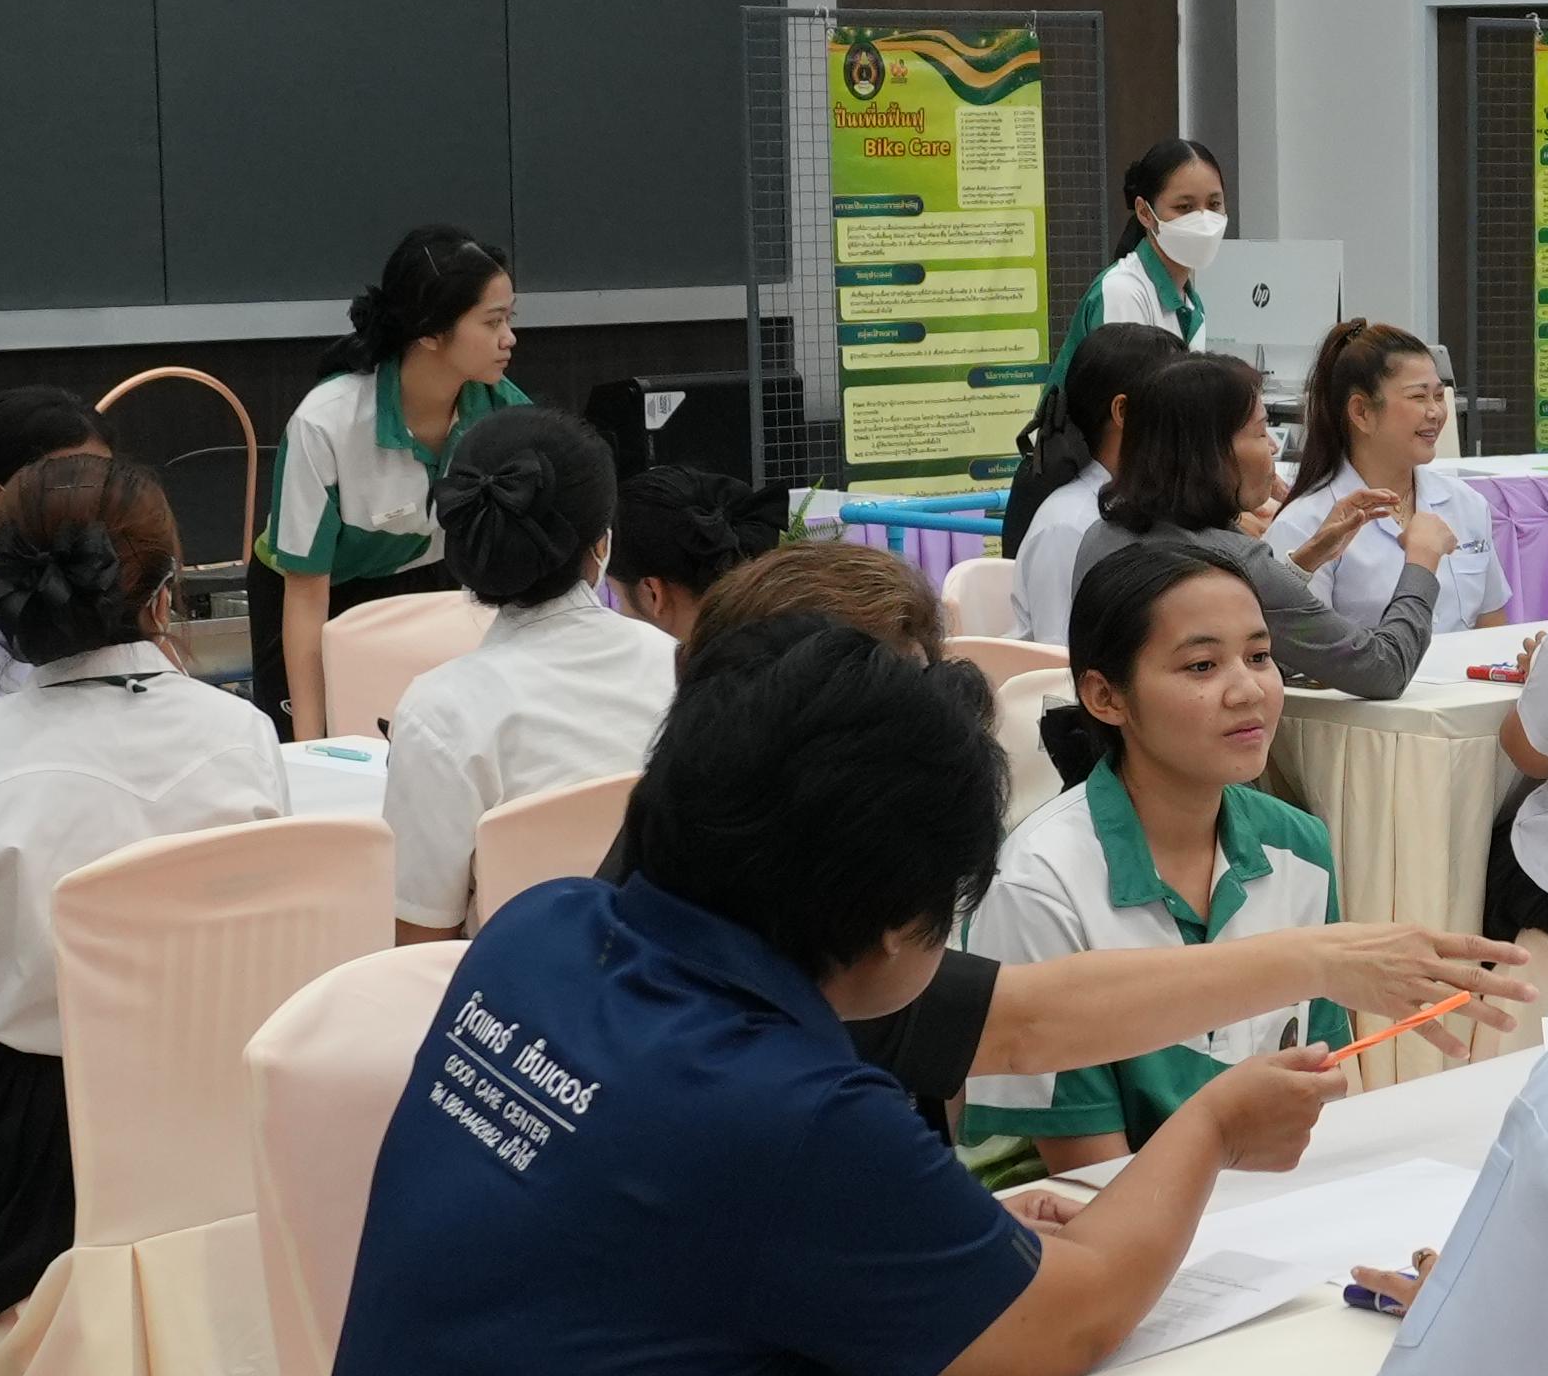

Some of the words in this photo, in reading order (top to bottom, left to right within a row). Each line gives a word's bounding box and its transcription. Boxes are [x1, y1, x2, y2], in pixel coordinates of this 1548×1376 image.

[864, 137, 905, 157] Bike
[909, 138, 951, 157] Care
[1252, 282, 1270, 309] hp
[444, 1054, 476, 1087] GOOD
[475, 1078, 505, 1110] CARE
[503, 1100, 551, 1145] CENTER
